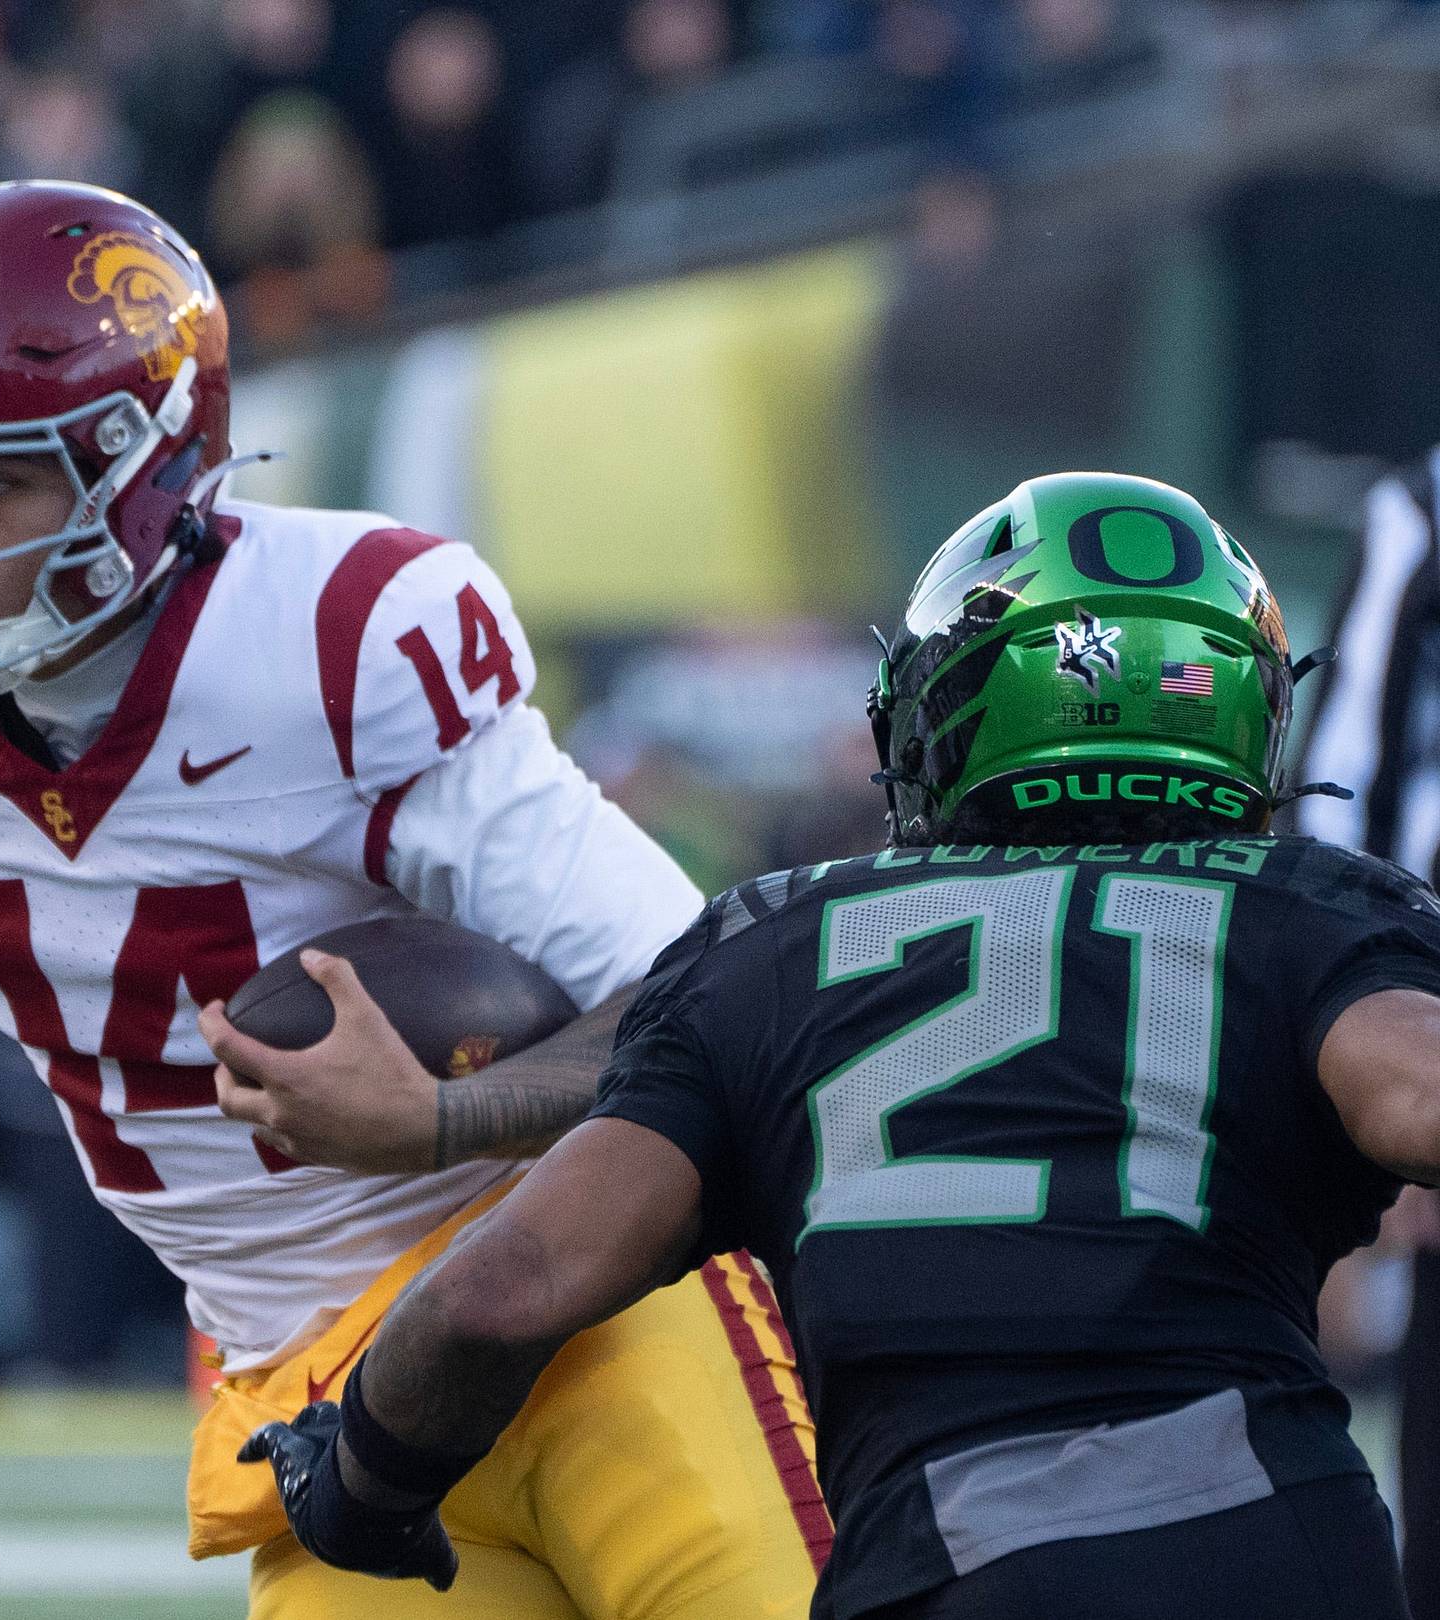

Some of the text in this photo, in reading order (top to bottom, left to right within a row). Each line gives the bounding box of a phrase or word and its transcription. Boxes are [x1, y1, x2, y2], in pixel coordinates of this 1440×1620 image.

[394, 581, 521, 753] 14
[1012, 773, 1249, 819] DUCKS
[794, 863, 1237, 1252] 21
